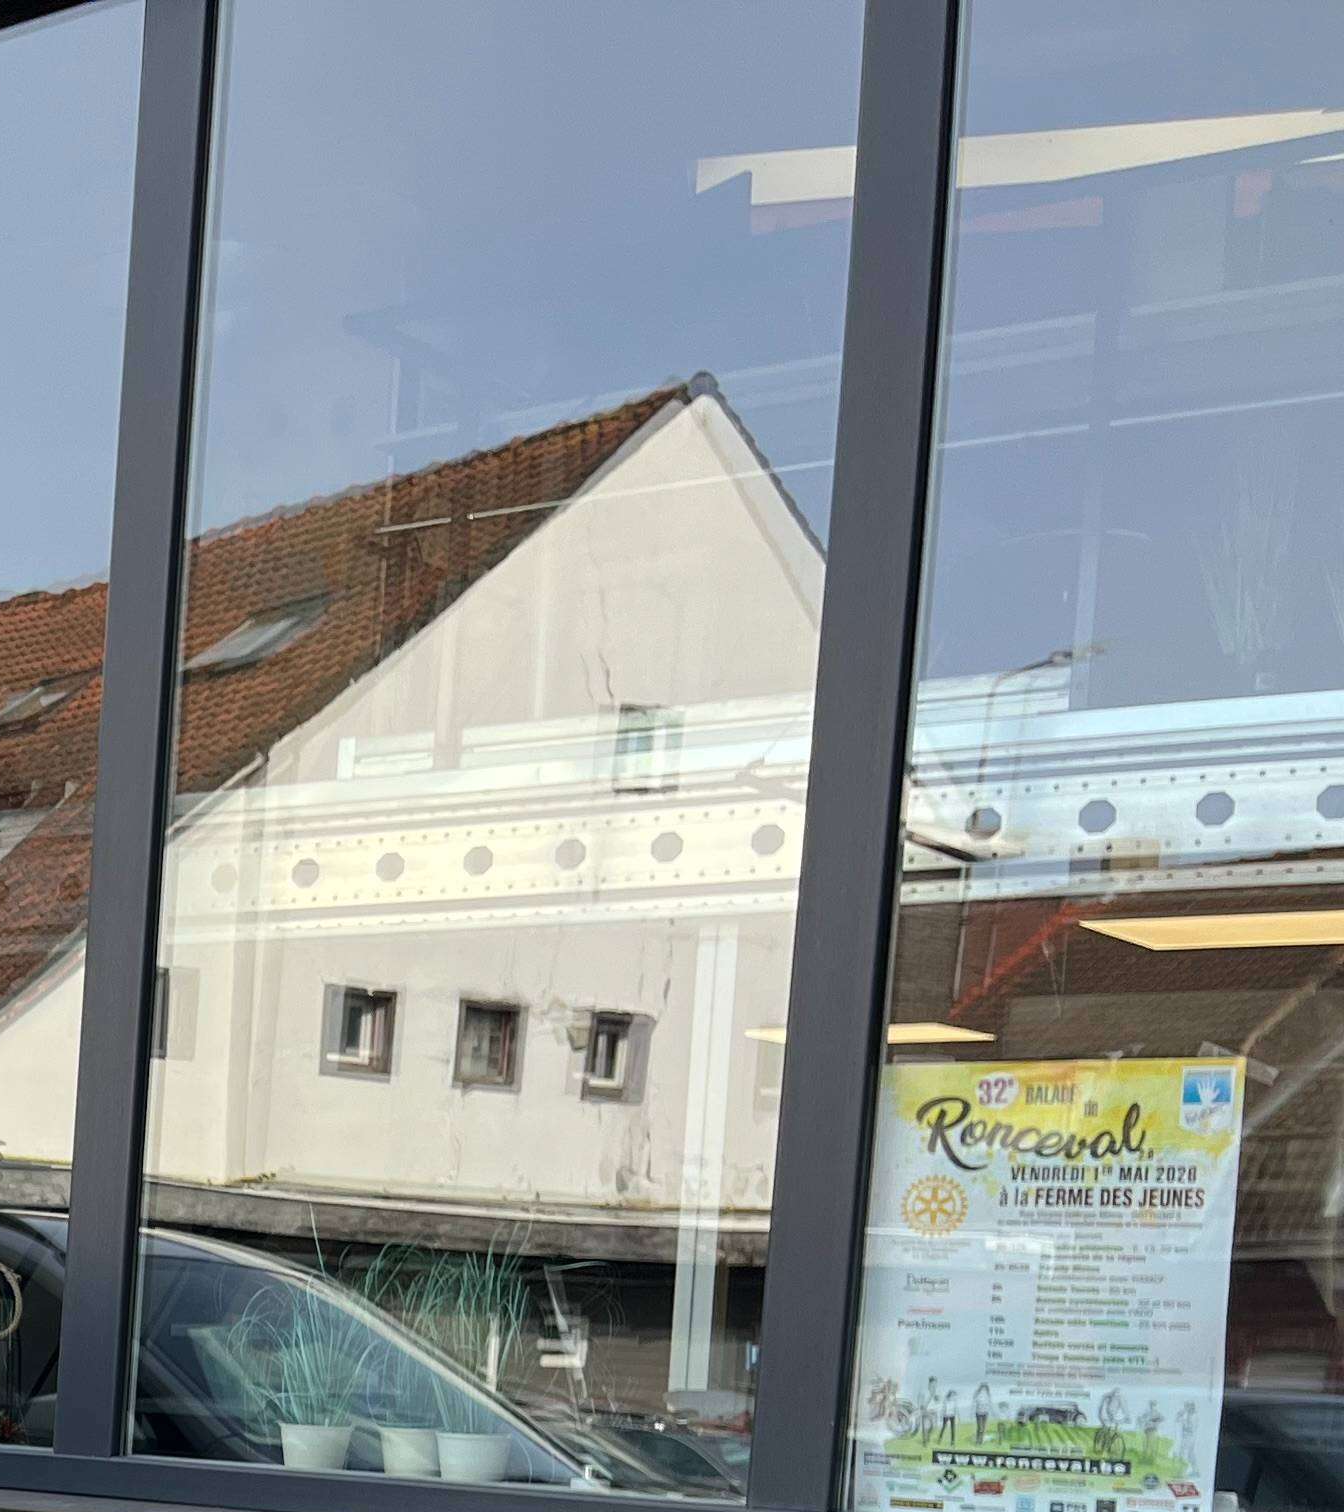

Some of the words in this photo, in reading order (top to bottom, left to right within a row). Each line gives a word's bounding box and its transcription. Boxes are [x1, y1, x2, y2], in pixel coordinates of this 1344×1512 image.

[1026, 1084, 1076, 1106] BALADE
[916, 1096, 1146, 1171] Ronceval
[1011, 1164, 1086, 1183] VENDREDI
[1119, 1164, 1150, 1182] MAI
[1012, 1187, 1030, 1207] la
[1034, 1187, 1096, 1207] FERME
[1100, 1187, 1133, 1207] DES
[1138, 1187, 1205, 1208] JEUNES
